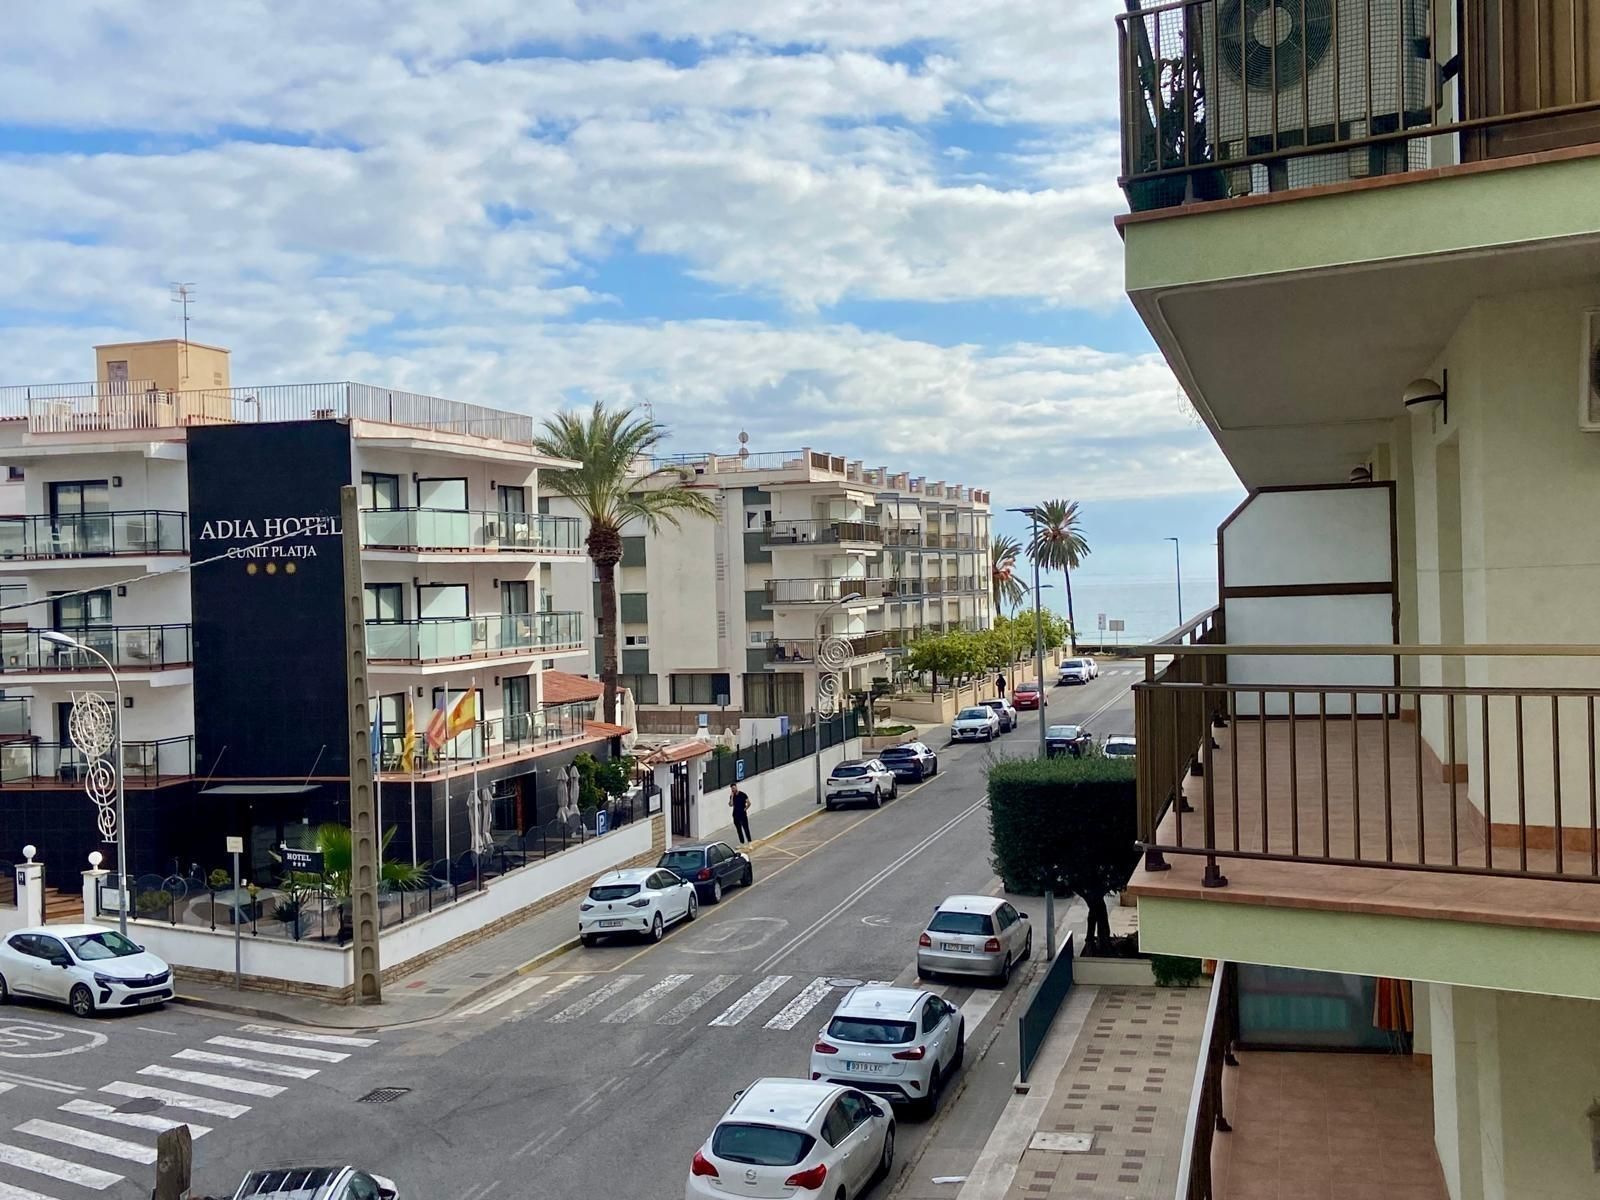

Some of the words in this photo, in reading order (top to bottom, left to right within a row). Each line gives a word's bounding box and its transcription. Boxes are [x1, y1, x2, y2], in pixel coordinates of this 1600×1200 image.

[200, 519, 259, 540] ADIA
[264, 516, 343, 537] HOTEL
[227, 546, 269, 559] CUNIT
[271, 545, 317, 559] PLATJA
[286, 852, 312, 862] HOTEL
